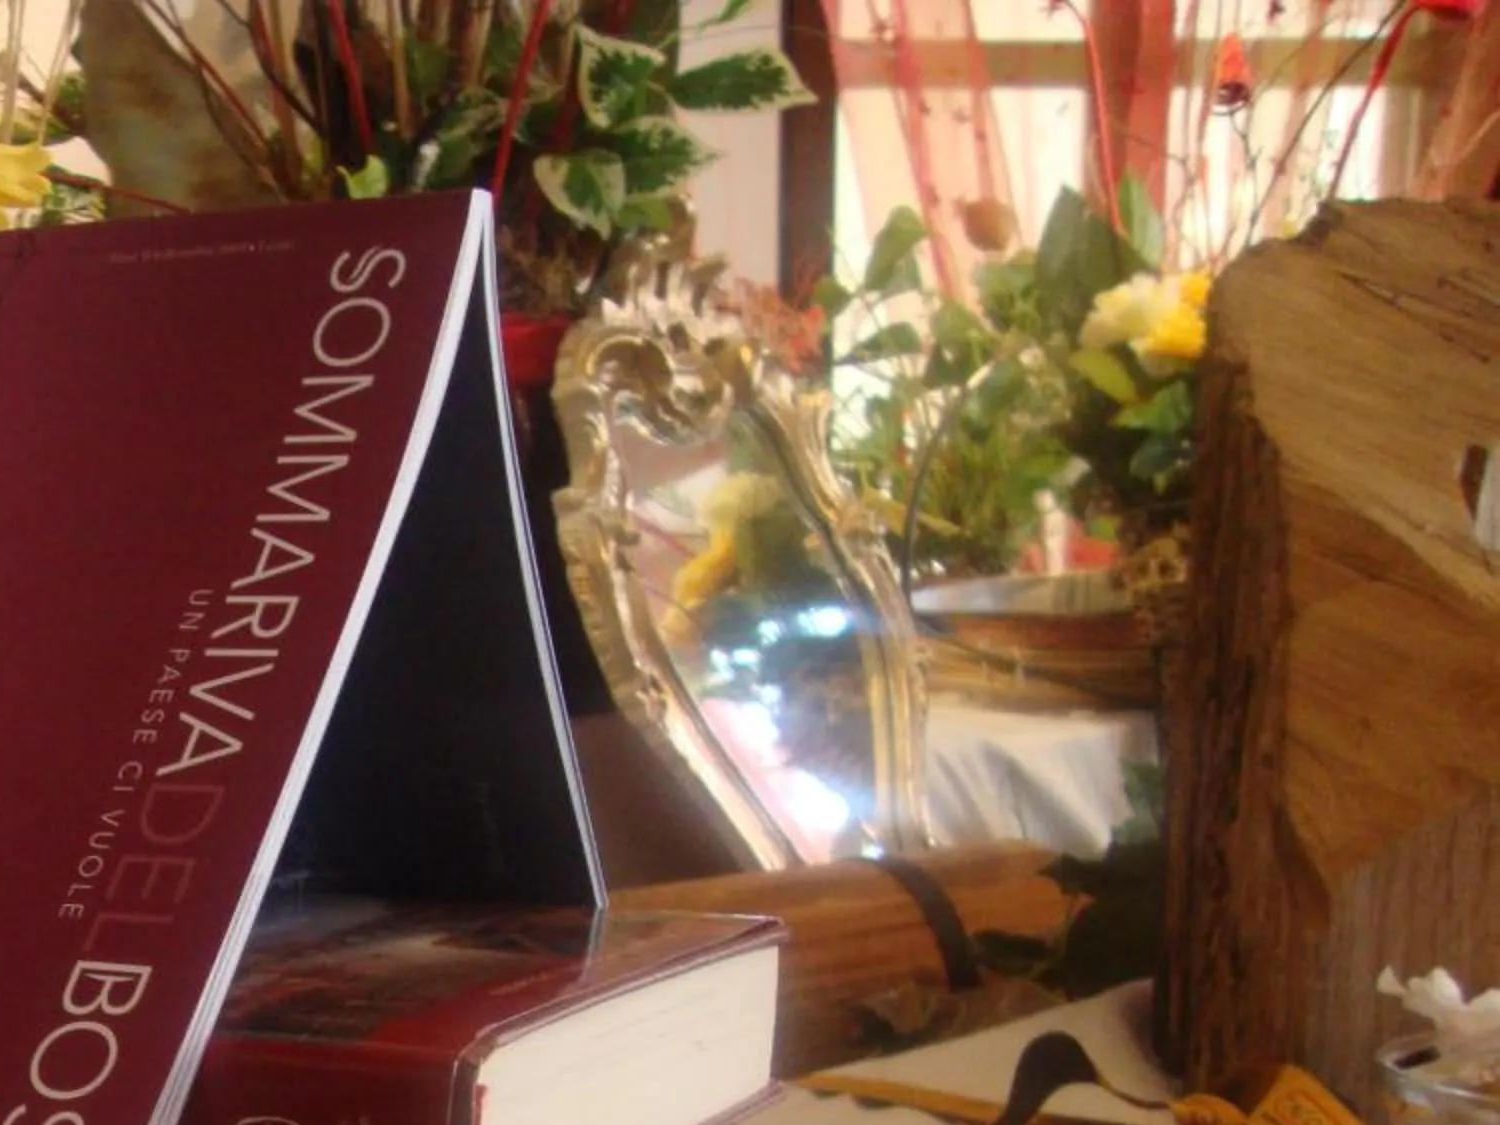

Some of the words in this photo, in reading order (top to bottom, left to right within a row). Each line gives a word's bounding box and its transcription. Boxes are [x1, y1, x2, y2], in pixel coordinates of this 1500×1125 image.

[156, 246, 406, 776] SOMMARIVA
[179, 589, 214, 631] UN
[132, 647, 192, 745] PAESE
[112, 761, 143, 792] CI
[57, 807, 125, 919] VUOLE
[83, 784, 226, 952] DEL
